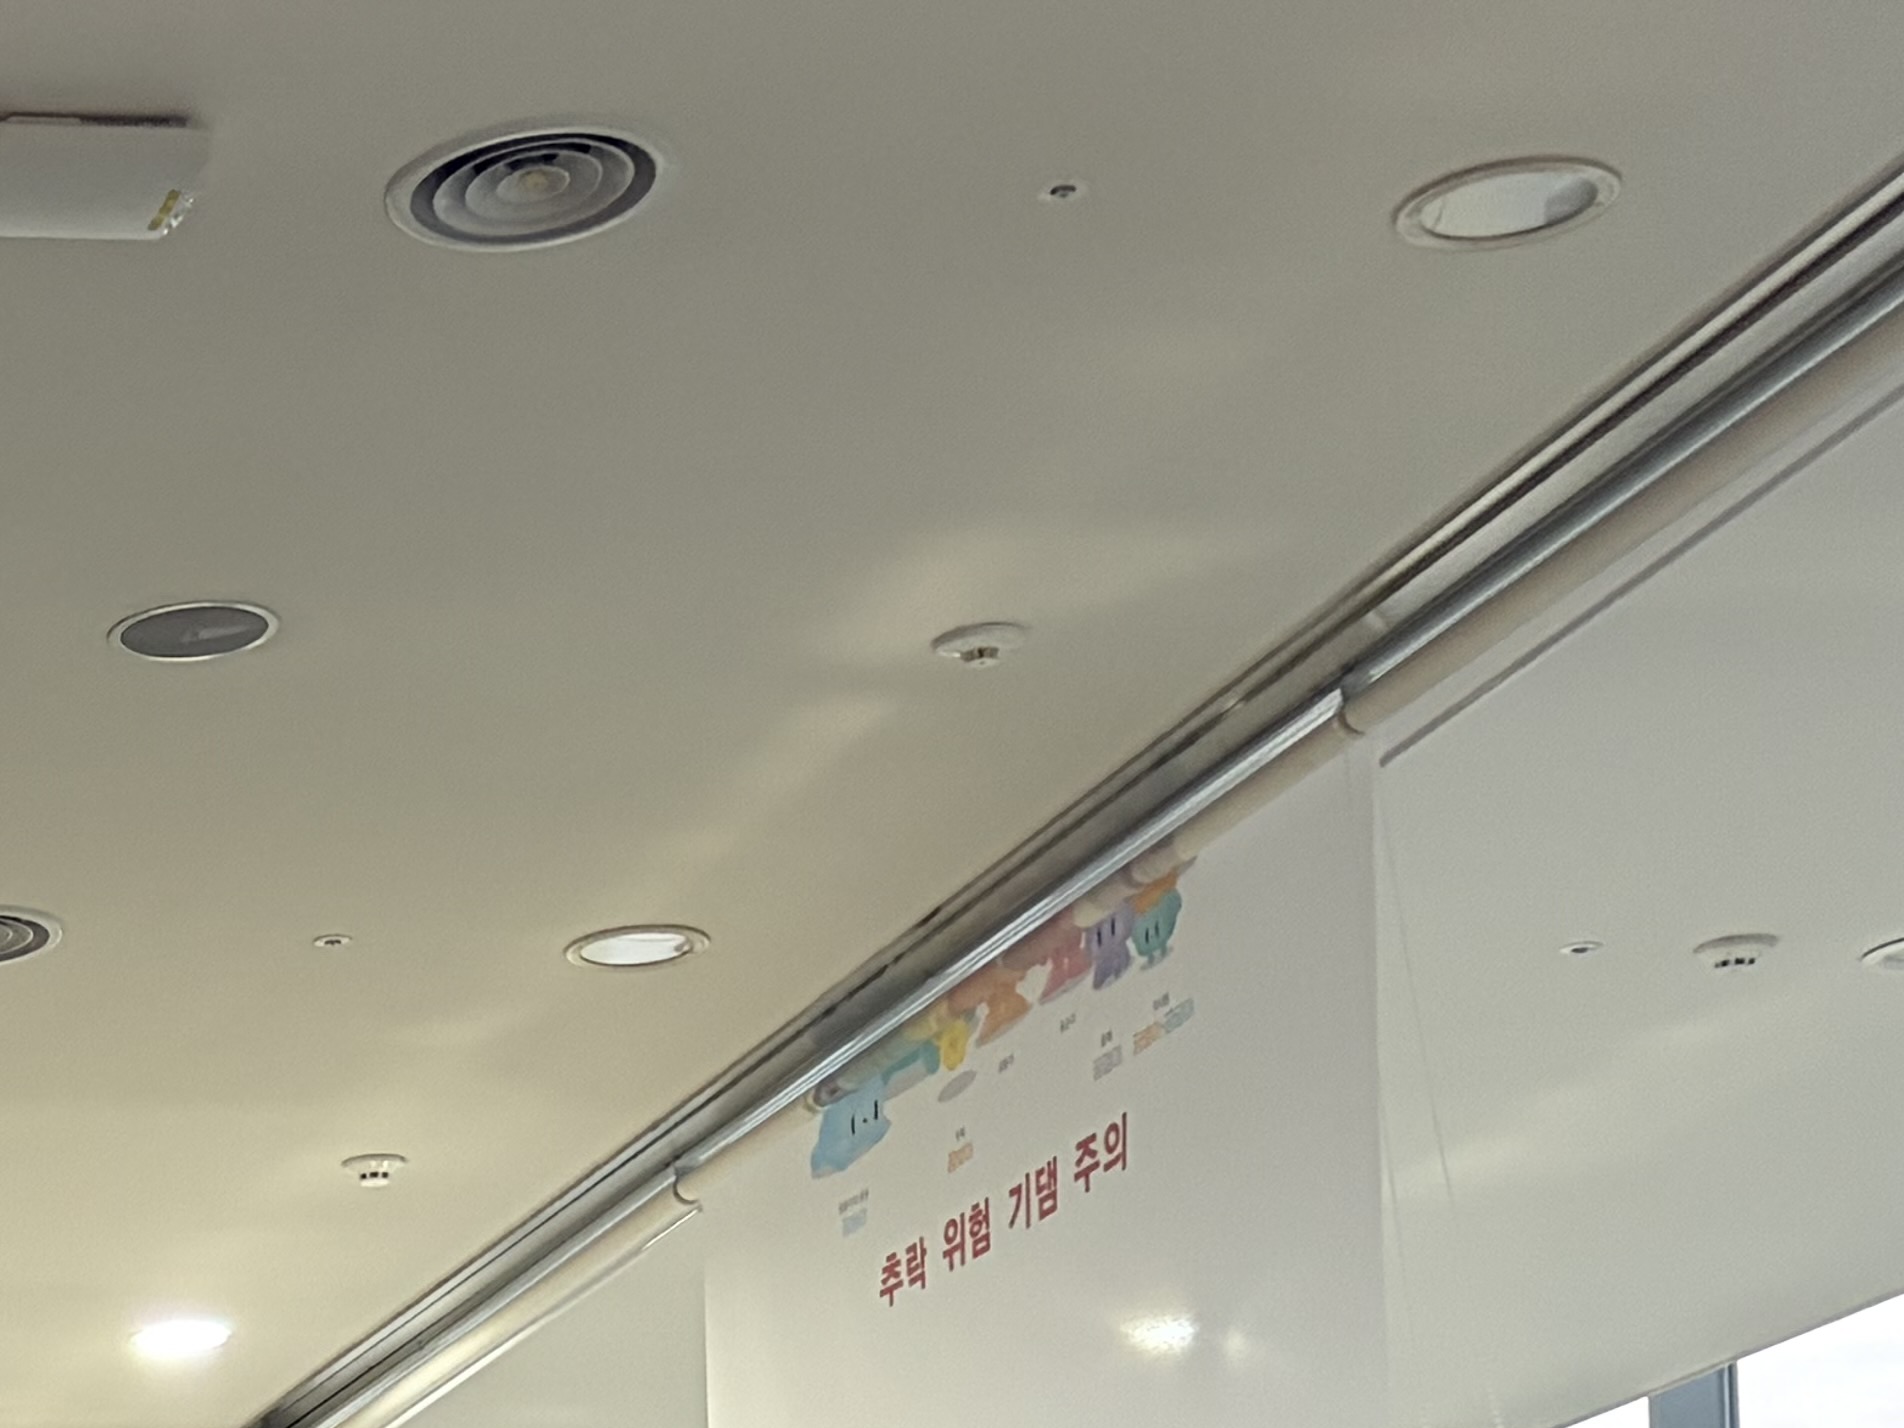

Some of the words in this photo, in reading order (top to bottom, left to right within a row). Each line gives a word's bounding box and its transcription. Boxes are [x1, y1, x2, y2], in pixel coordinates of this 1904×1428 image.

[879, 1237, 927, 1306] 추락
[942, 1198, 991, 1271] 위험
[1008, 1156, 1058, 1230] 기댐
[1073, 1112, 1128, 1193] 주의
